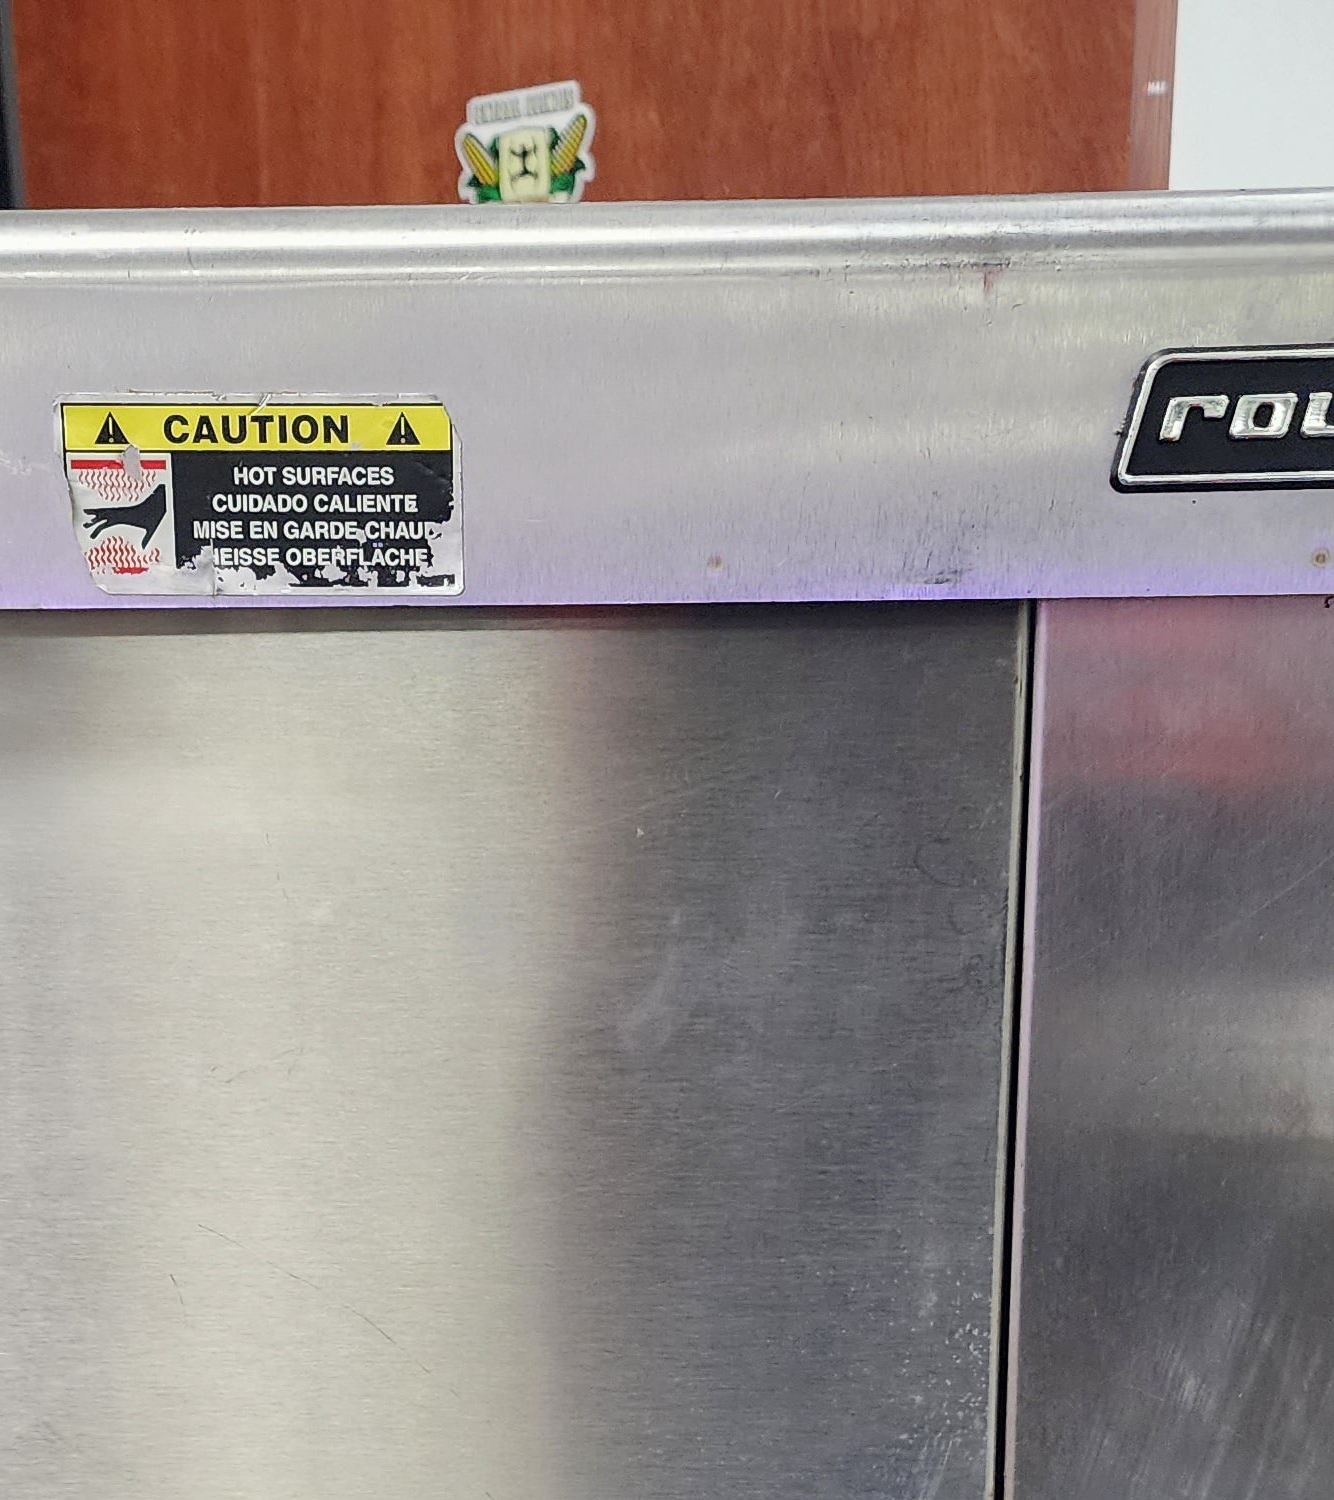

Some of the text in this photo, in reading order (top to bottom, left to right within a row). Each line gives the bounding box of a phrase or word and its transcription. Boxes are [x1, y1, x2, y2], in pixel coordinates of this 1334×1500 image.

[163, 414, 350, 445] CAUTION
[233, 465, 395, 486] HOT SURFACES
[211, 493, 419, 513] CUIDADO CALIENTE
[193, 520, 244, 540] MISE
[249, 520, 278, 540] EN
[283, 520, 359, 540] GARDE
